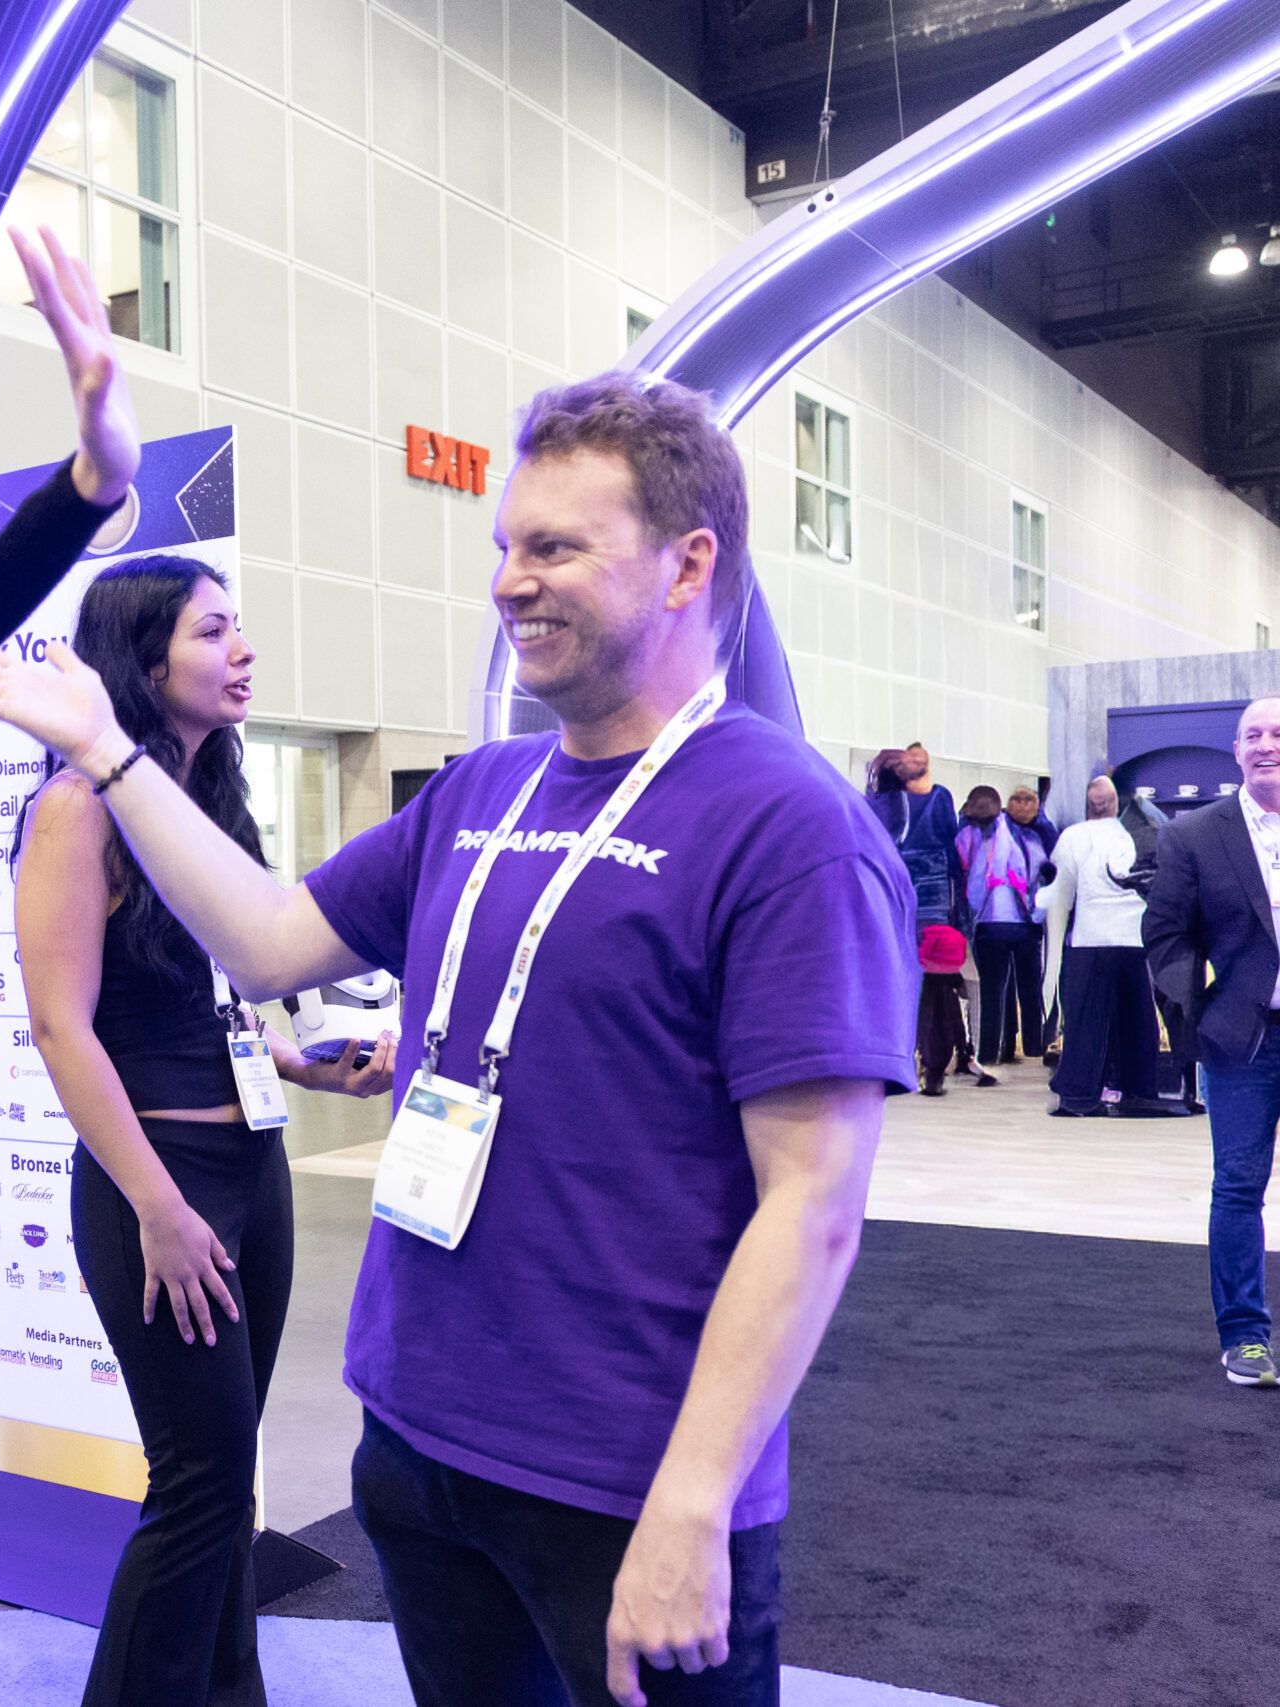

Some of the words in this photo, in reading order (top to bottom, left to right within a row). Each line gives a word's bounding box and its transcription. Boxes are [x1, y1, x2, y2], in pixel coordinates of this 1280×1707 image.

[762, 163, 780, 180] 15
[406, 424, 489, 495] EXIT
[15, 632, 67, 663] Yo
[453, 829, 669, 876] DRAMPRK
[13, 1030, 36, 1047] Sil
[11, 1154, 61, 1174] Bronze
[26, 1327, 57, 1343] Media
[59, 1333, 102, 1350] Partners
[28, 1351, 63, 1370] Vending
[91, 1359, 117, 1373] GoGo
